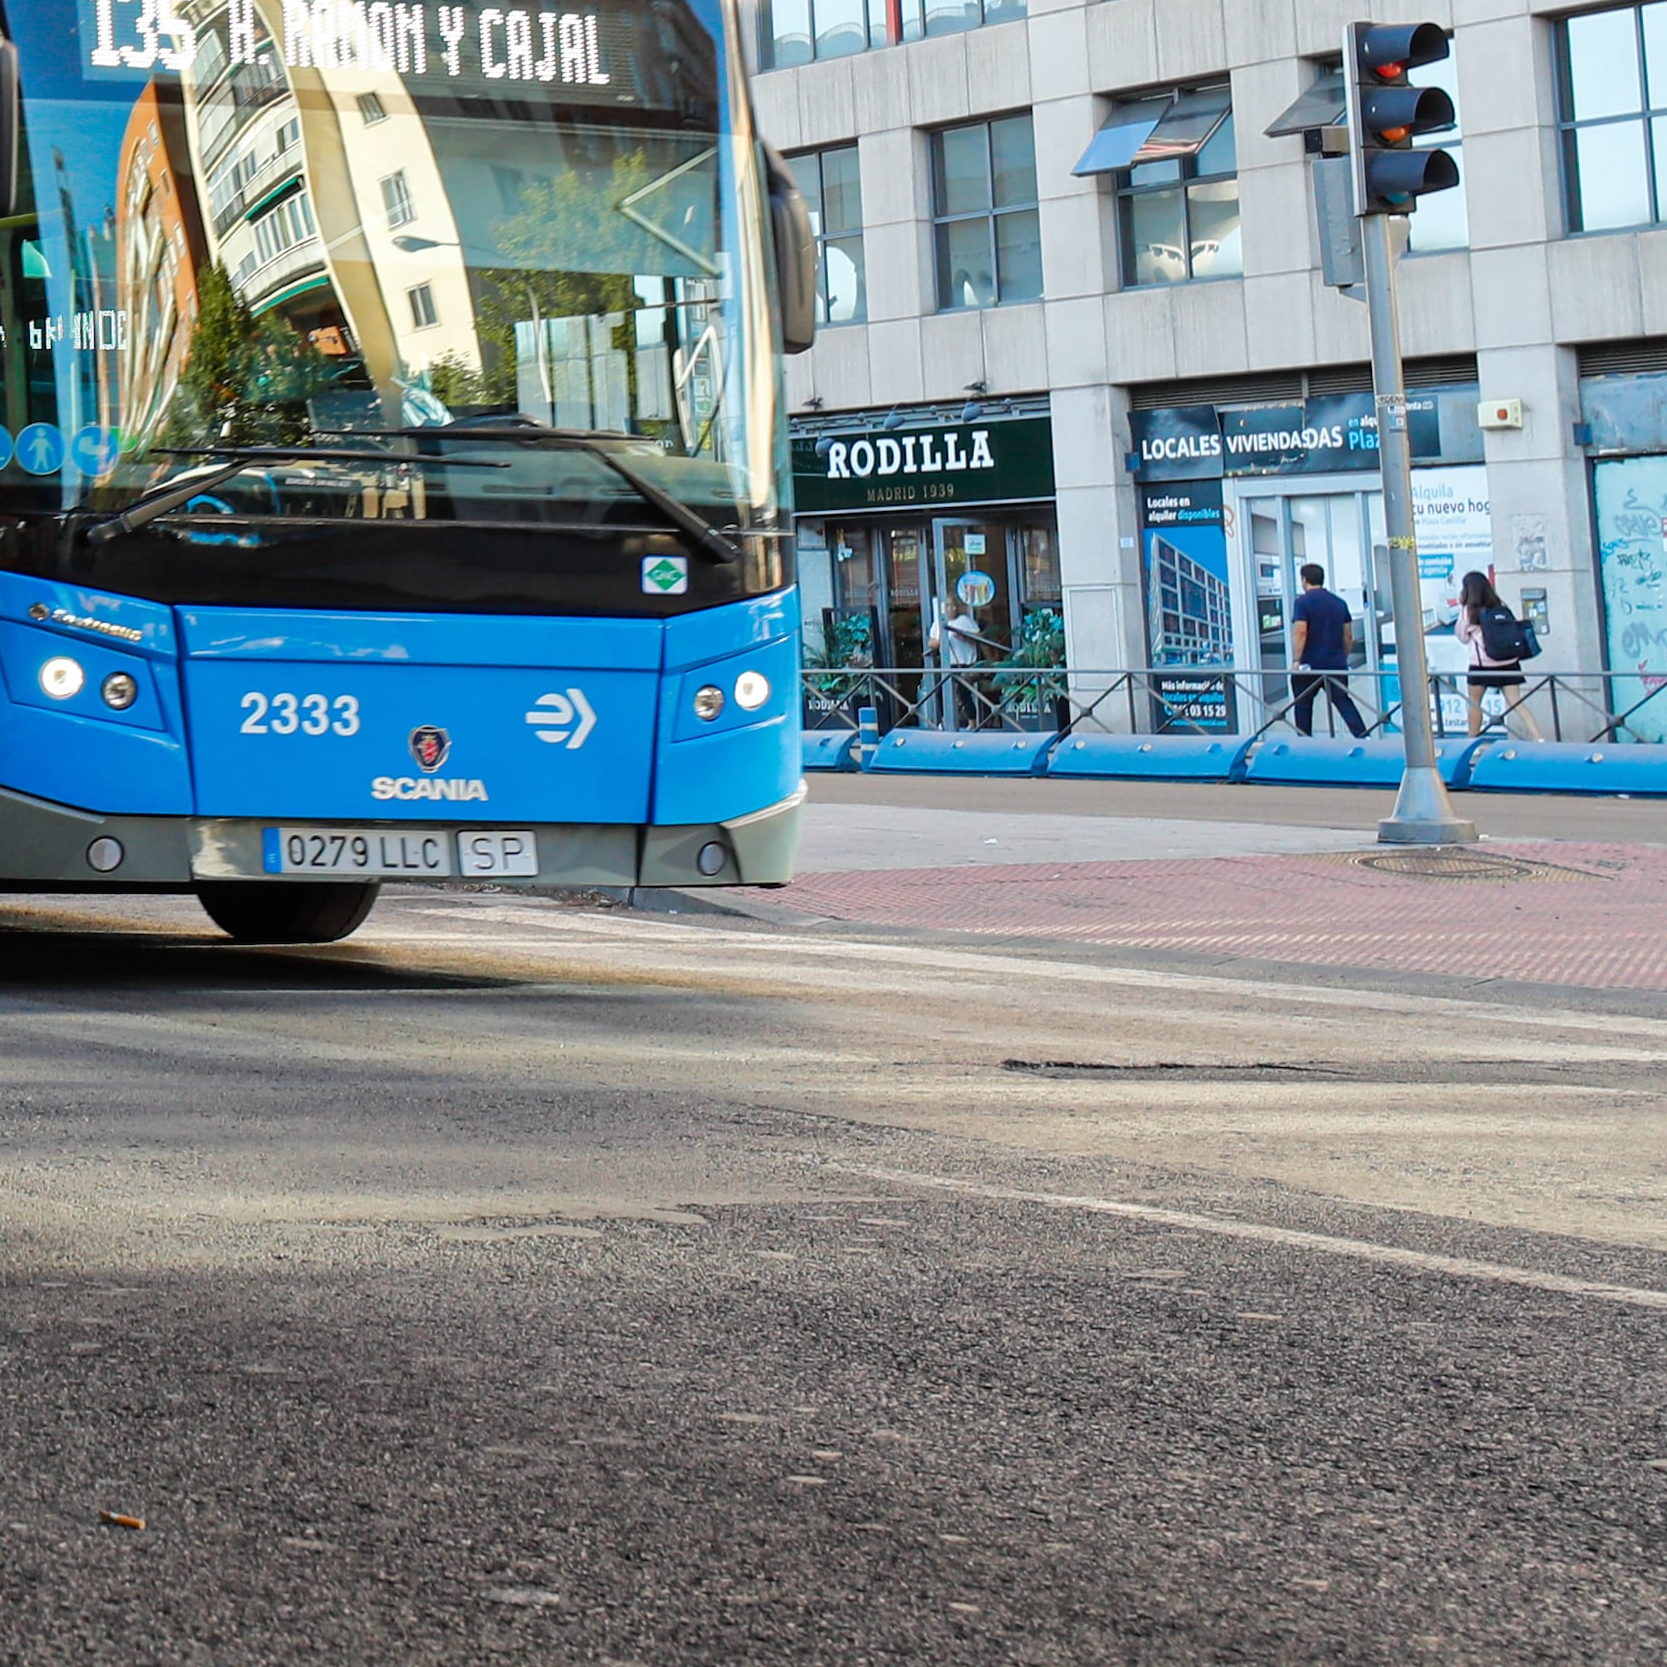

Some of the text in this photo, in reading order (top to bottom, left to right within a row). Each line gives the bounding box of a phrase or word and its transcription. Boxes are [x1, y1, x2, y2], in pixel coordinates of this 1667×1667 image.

[438, 5, 464, 76] Y
[478, 8, 611, 84] CAJAL
[1348, 418, 1359, 427] en
[827, 430, 995, 479] RODILLA
[1142, 434, 1221, 460] LOCALES
[1226, 429, 1310, 454] VIVIENDAS
[867, 483, 955, 503] MADRID 1939
[1147, 497, 1190, 509] Locales en
[1148, 508, 1220, 523] alquiler disponibles
[1428, 502, 1465, 515] nuevo
[1468, 498, 1490, 515] hog
[240, 691, 360, 736] 2333
[1190, 704, 1201, 717] 03
[1203, 704, 1214, 717] 15
[371, 776, 489, 802] SCANIA
[287, 834, 439, 870] 0279 LLC
[470, 837, 524, 871] SP
